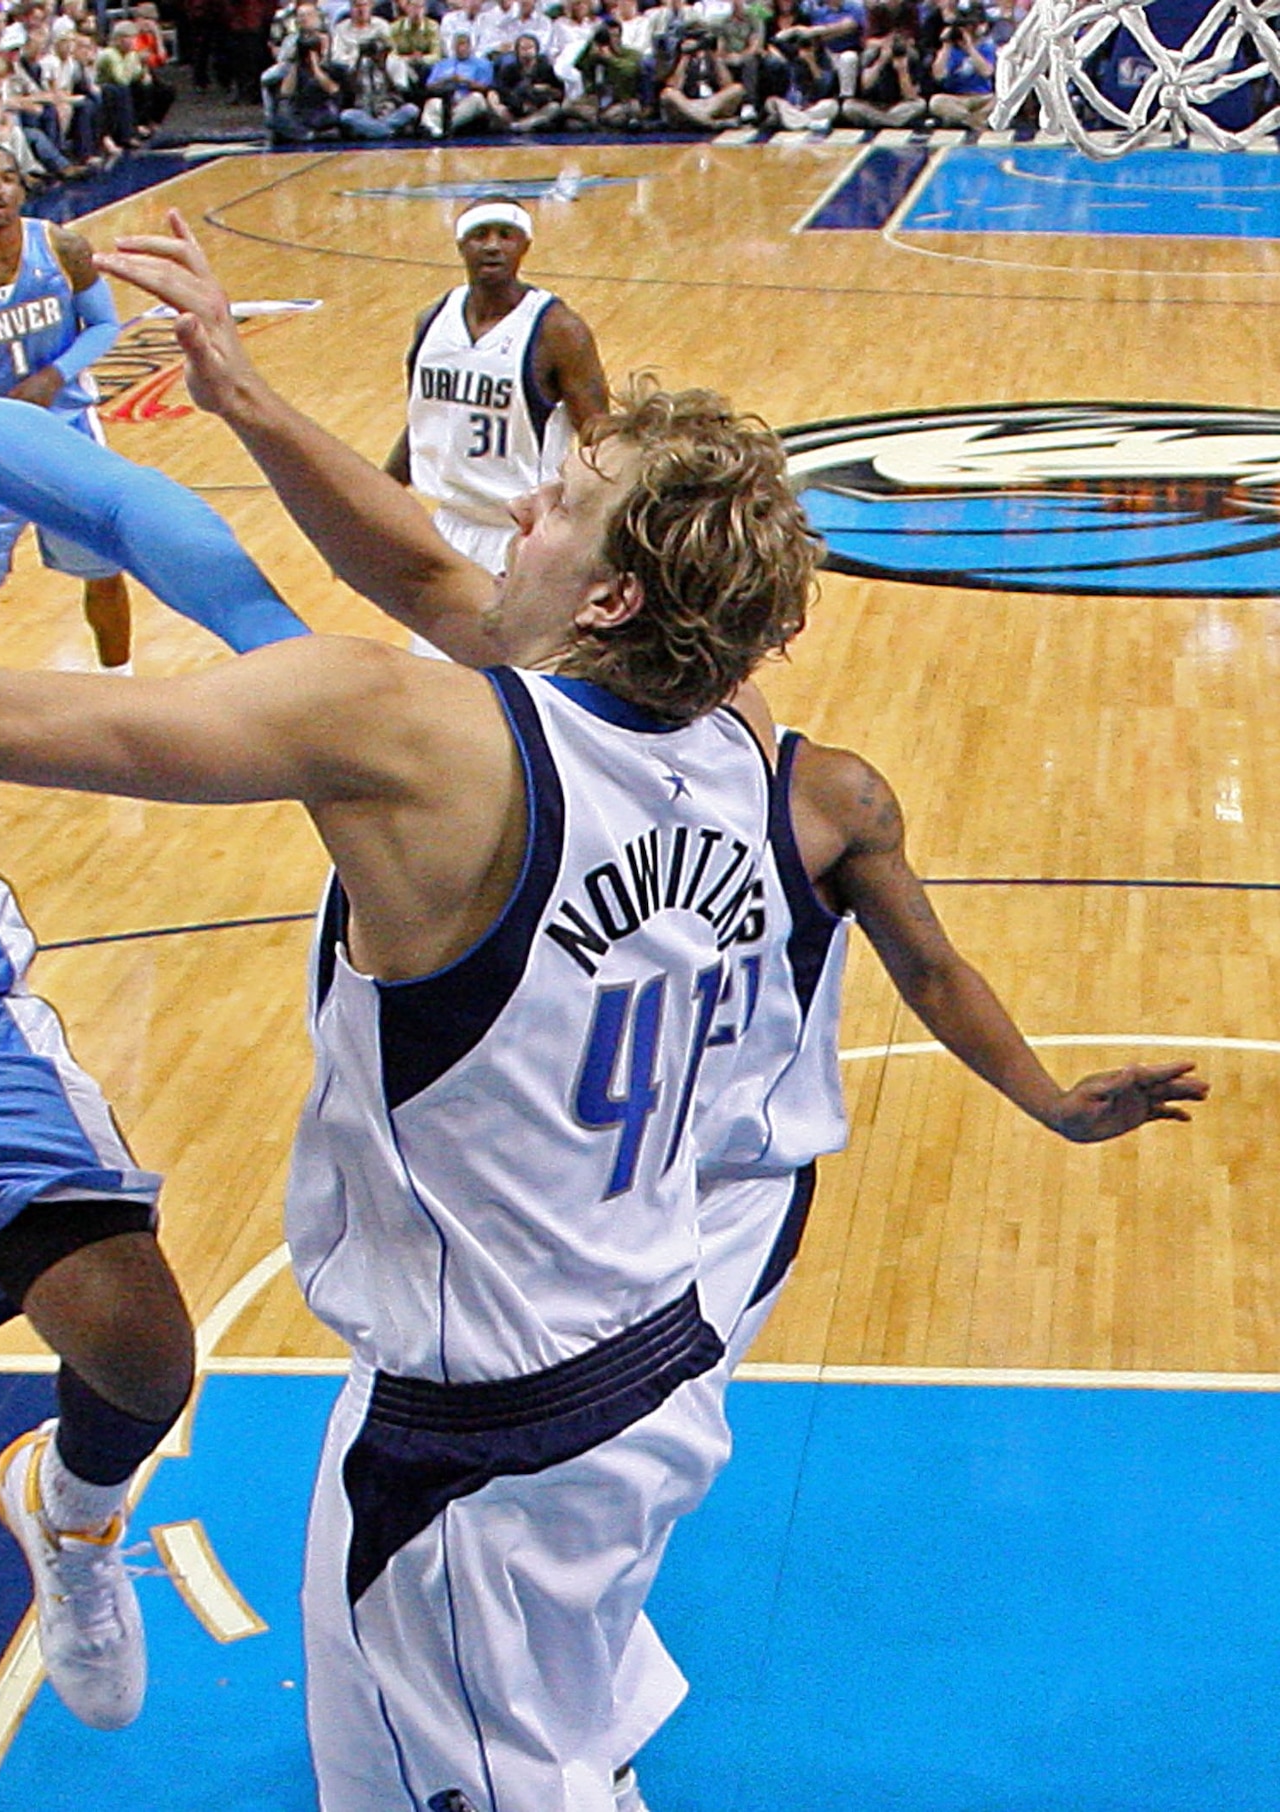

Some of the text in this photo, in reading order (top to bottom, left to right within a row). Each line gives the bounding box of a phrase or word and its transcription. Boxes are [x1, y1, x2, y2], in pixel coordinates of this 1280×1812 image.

[10, 339, 30, 377] 1
[420, 366, 513, 409] DALLAS
[467, 413, 509, 458] 31
[570, 962, 721, 1201] 41
